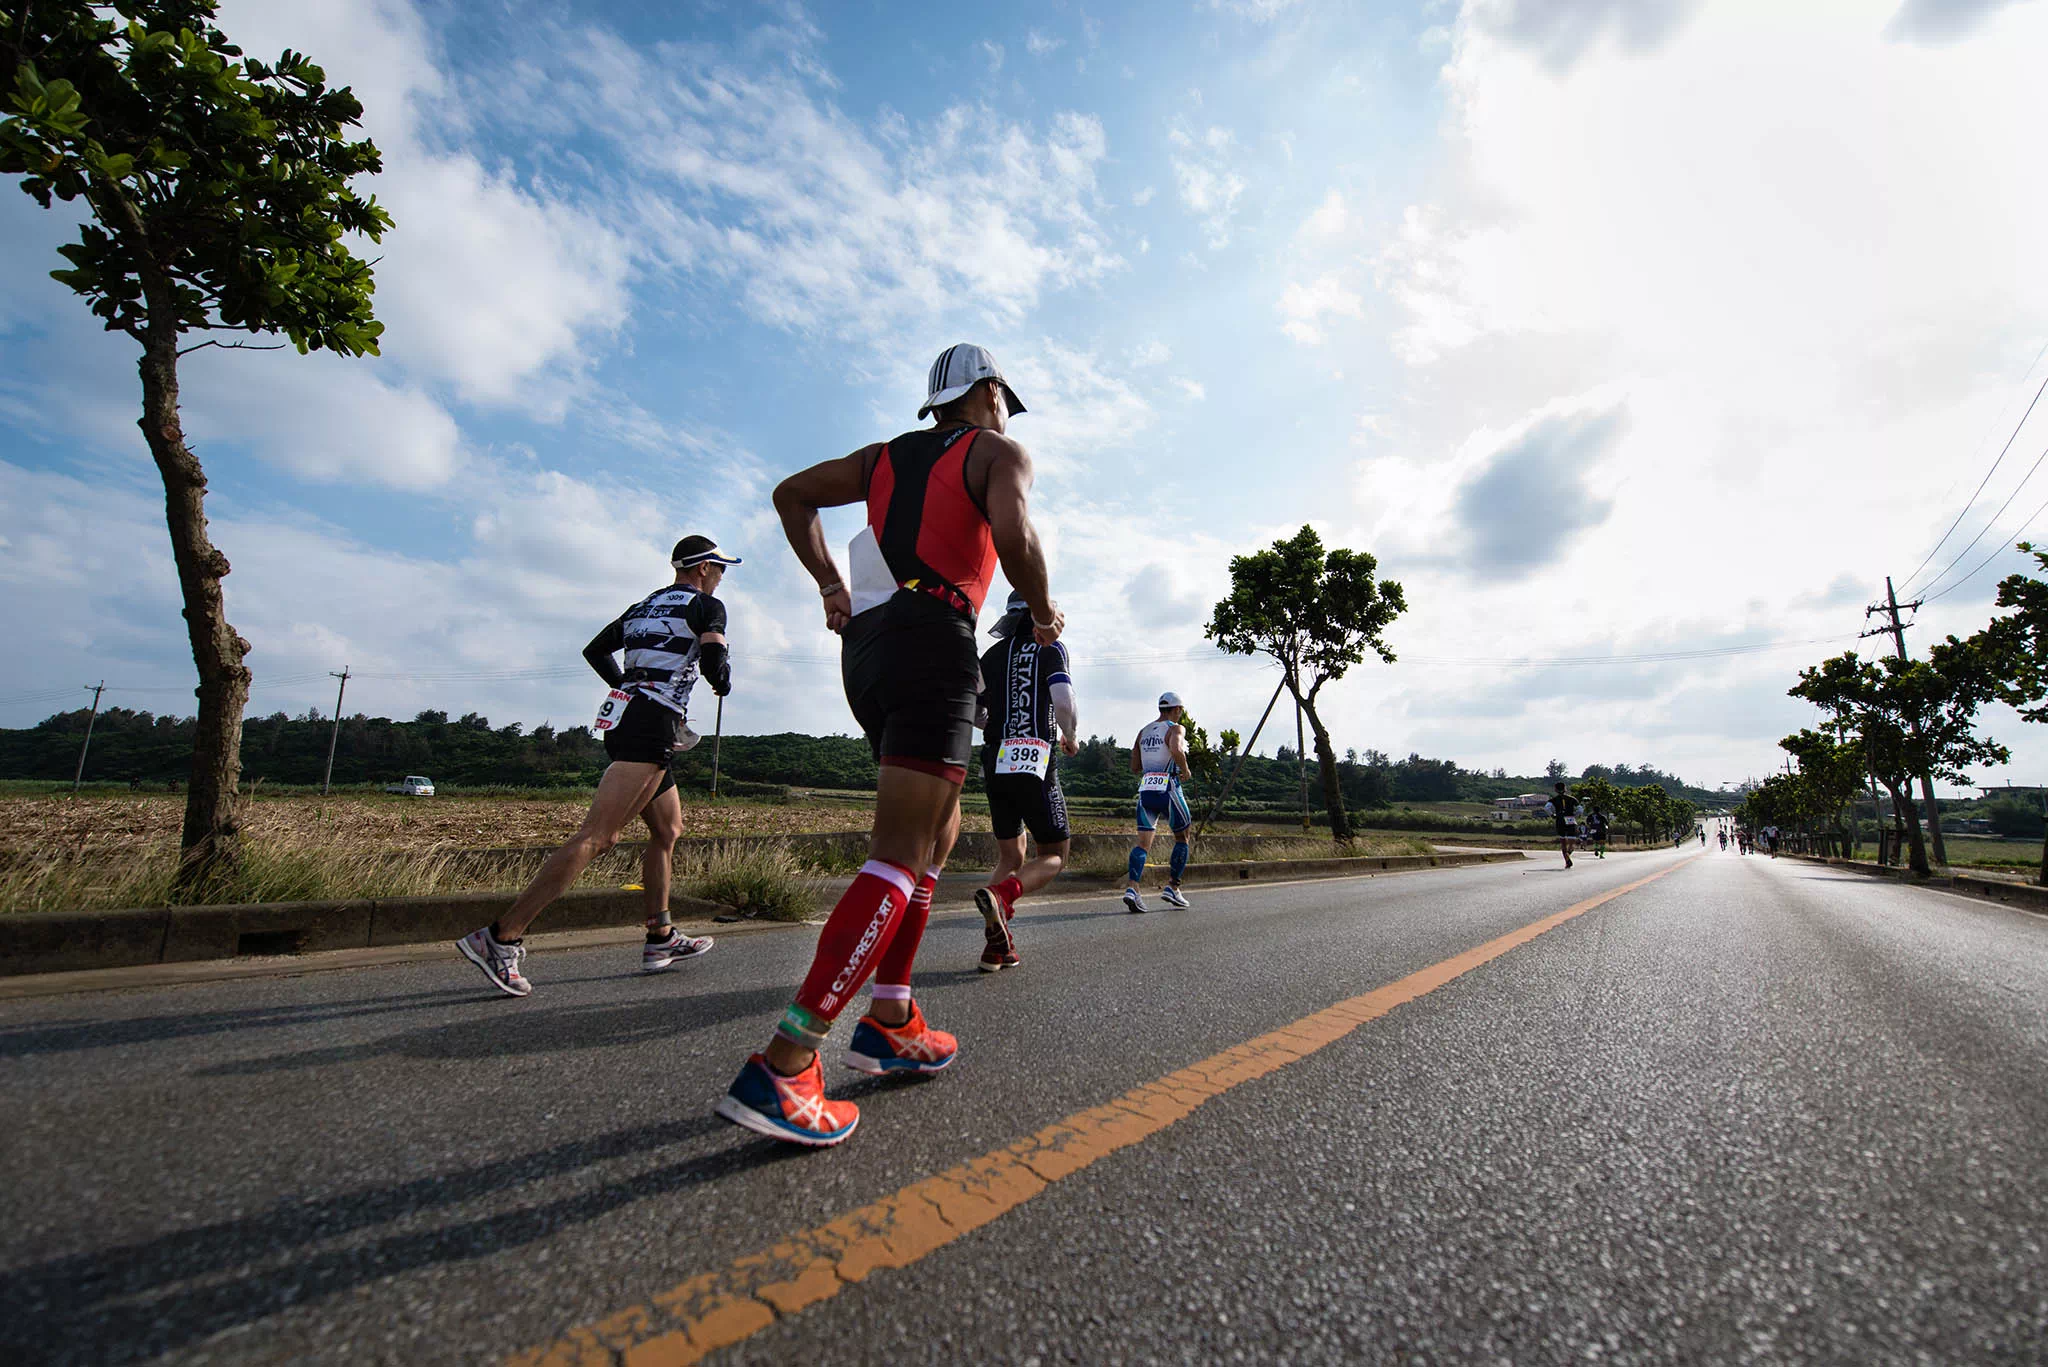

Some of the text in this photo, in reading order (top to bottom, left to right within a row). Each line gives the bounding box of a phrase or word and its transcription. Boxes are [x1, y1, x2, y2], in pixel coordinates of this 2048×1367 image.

[1011, 651, 1020, 708] TRIATHLON
[1010, 747, 1039, 762] 398
[1018, 764, 1037, 772] JTA
[1144, 776, 1164, 785] 1230
